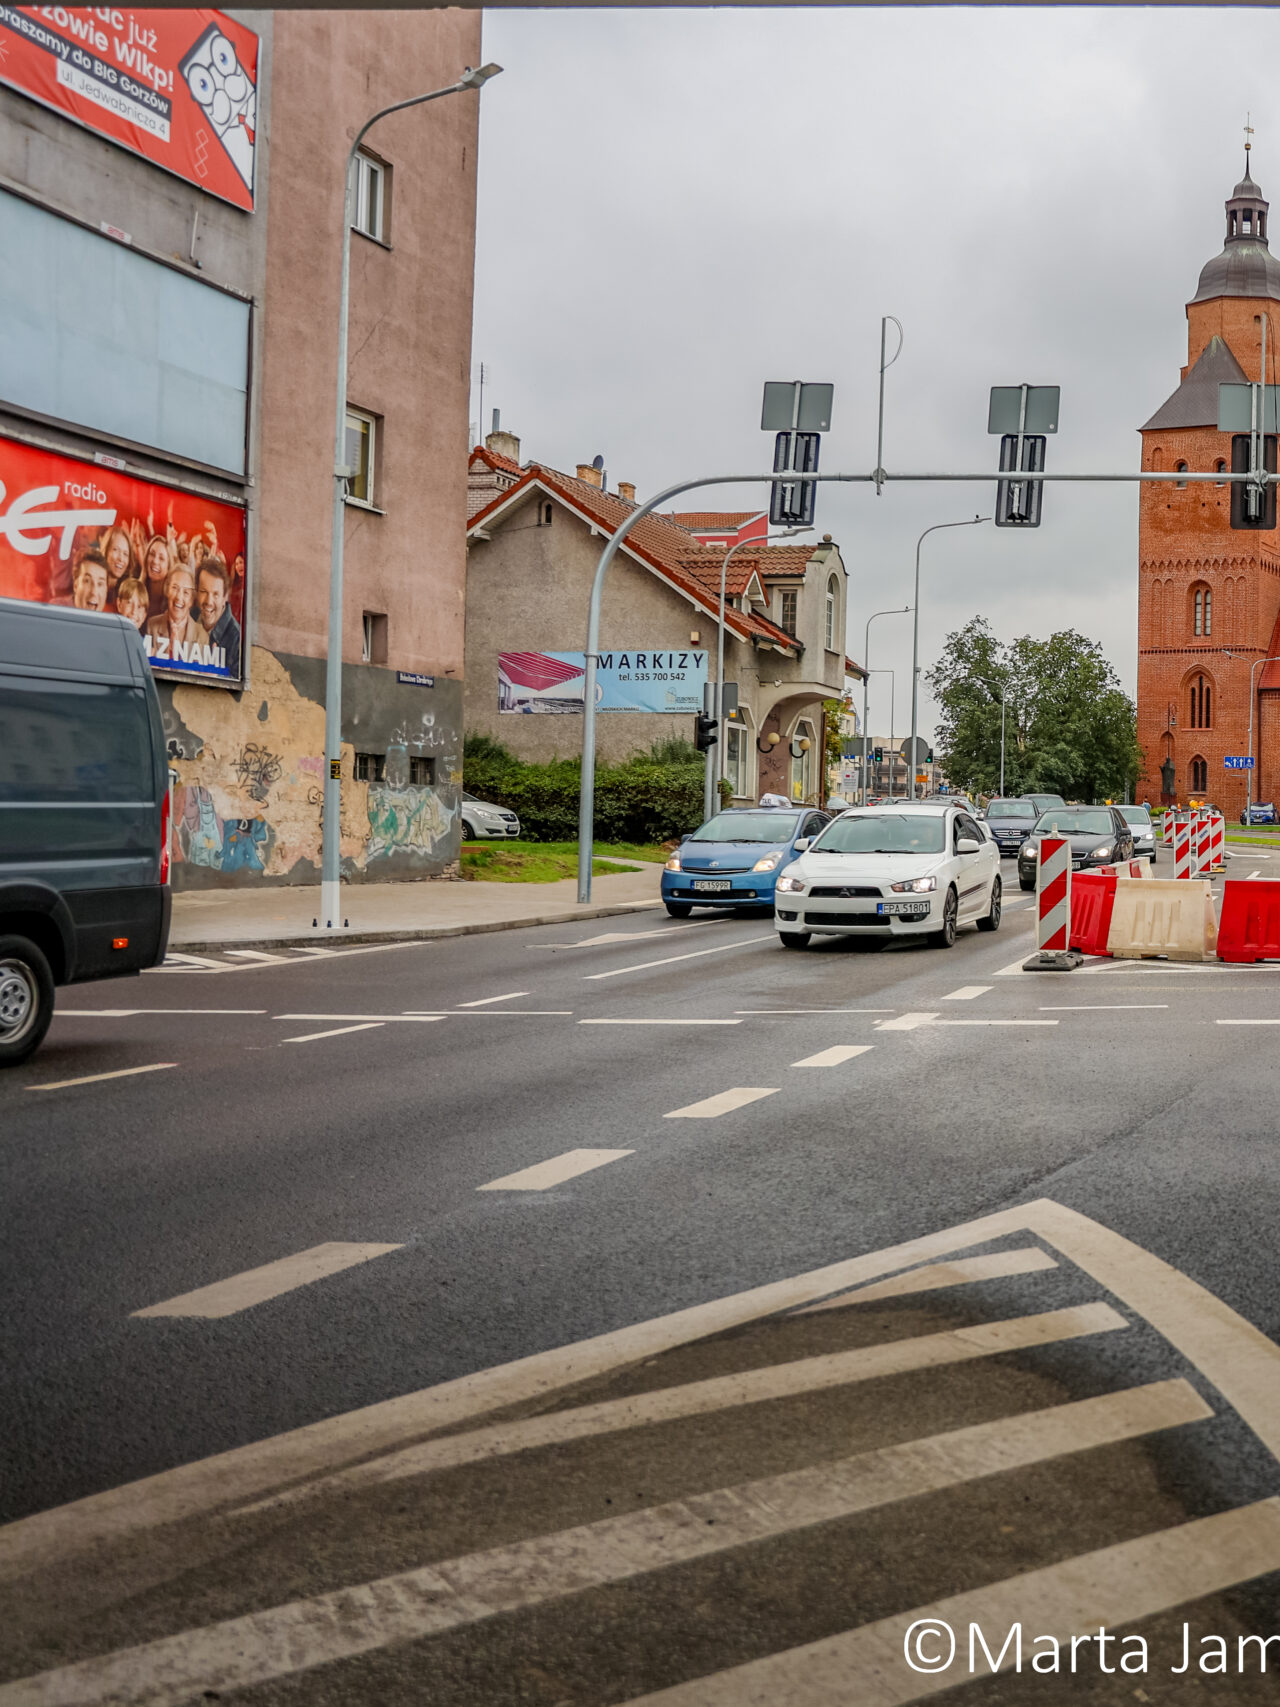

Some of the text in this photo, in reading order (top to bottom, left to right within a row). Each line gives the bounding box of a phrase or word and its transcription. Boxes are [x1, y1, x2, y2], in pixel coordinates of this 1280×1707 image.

[127, 15, 158, 53] już
[113, 36, 174, 92] Wlkp!
[72, 49, 92, 70] do
[94, 60, 118, 84] BIG
[119, 76, 169, 114] Gorzów
[61, 68, 166, 135] ul. Jedwabnicza 4
[101, 455, 119, 467] ams
[64, 481, 107, 504] radio
[156, 637, 170, 660] Z
[172, 639, 226, 668] NAMI
[597, 653, 704, 669] MARKIZY
[619, 673, 686, 681] tel. 535 700 542
[695, 881, 729, 889] FG 1599R
[884, 903, 928, 913] EPA 51801
